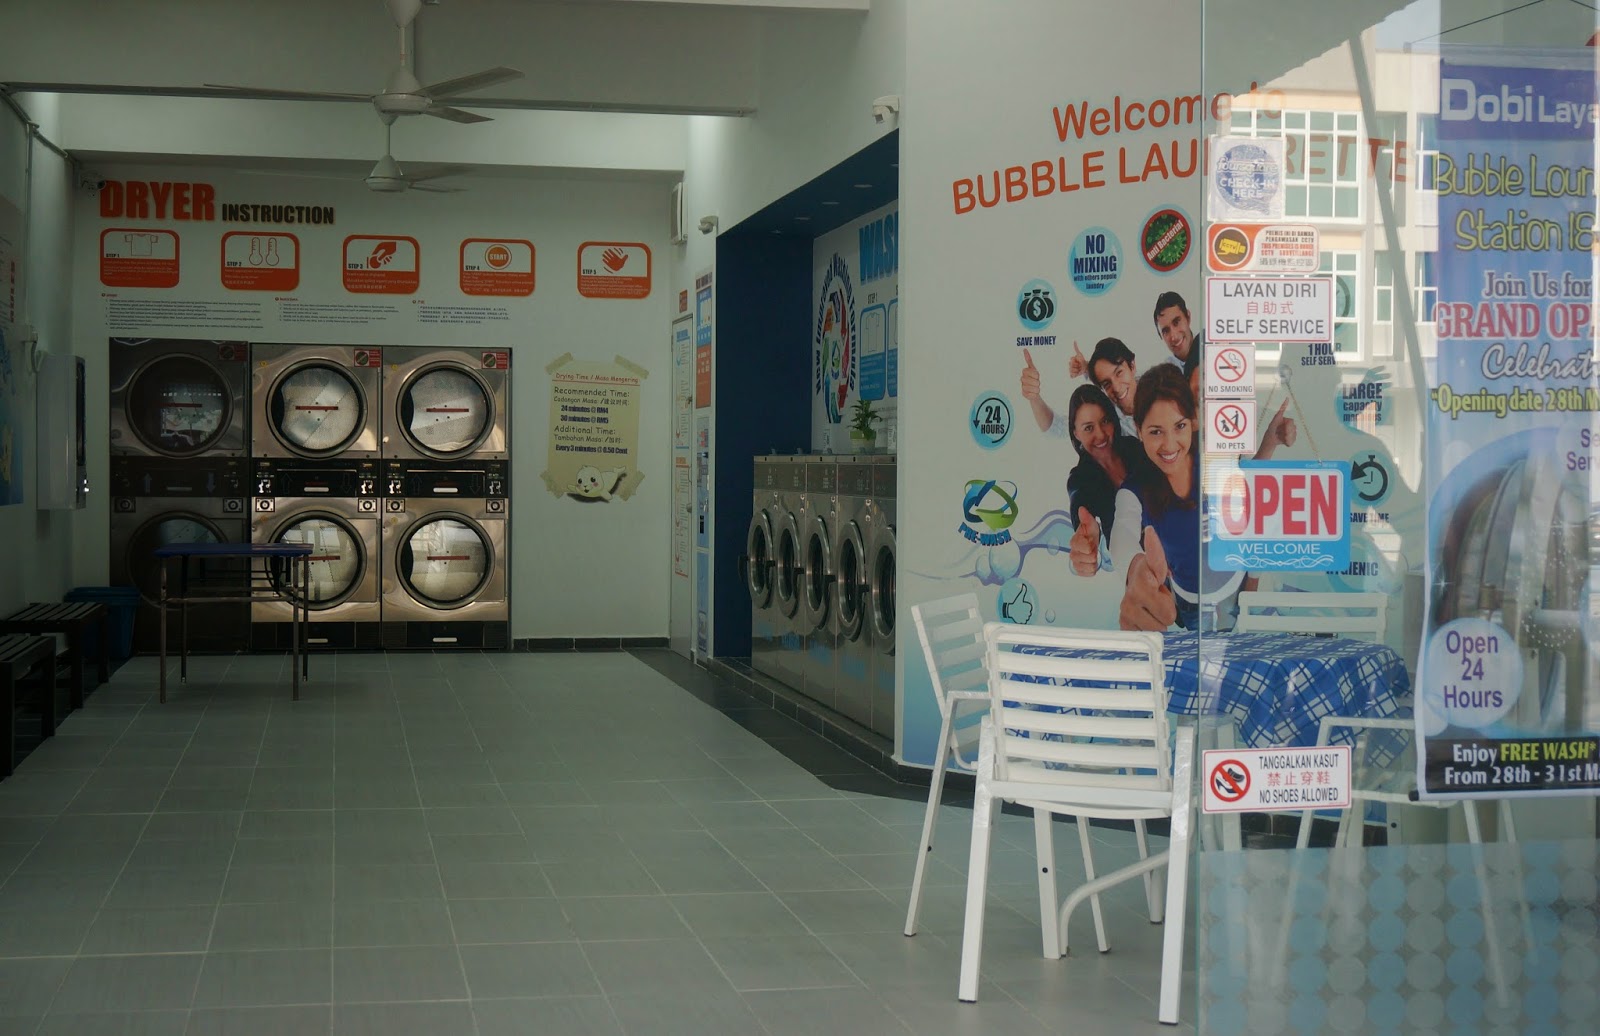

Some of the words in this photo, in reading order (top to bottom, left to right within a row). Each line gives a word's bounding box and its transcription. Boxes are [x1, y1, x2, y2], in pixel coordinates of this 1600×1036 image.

[1441, 78, 1533, 122] Dobi
[1052, 92, 1233, 142] Welcome
[952, 150, 1106, 215] BUBBLE
[1119, 134, 1411, 184] LAURETTE
[1217, 156, 1278, 175] foursquare
[1432, 152, 1525, 197] Bubble
[1220, 178, 1275, 189] CHECK-IN
[100, 180, 215, 221] DRYER
[222, 203, 334, 225] INSTRUCTION
[1232, 189, 1263, 198] HERE
[1456, 209, 1562, 251] Station
[859, 210, 898, 286] WAS
[1085, 234, 1105, 255] NO
[1147, 244, 1160, 260] Anti
[1156, 220, 1184, 252] Bacterial
[1073, 255, 1117, 274] MIXING
[1086, 282, 1104, 290] laundry
[1224, 283, 1276, 297] LAYAN
[1284, 283, 1316, 298] DIRI
[1484, 272, 1526, 297] Join
[1531, 272, 1558, 297] Us
[1564, 272, 1592, 297] for
[1247, 301, 1294, 315] 自助式
[1216, 319, 1253, 334] SELF
[1259, 319, 1324, 334] SERVICE
[1432, 302, 1540, 338] GRAND
[1016, 336, 1033, 347] SAVE
[1034, 335, 1056, 346] MONEY
[1308, 344, 1313, 356] 1
[1315, 343, 1341, 355] HOUR
[1301, 357, 1317, 366] SELF
[1319, 356, 1348, 365] SERV
[1482, 343, 1599, 380] Celebrat
[554, 386, 607, 396] Recommended
[610, 389, 630, 398] Time:
[1342, 383, 1382, 399] LARGE
[1508, 386, 1543, 412] date
[1545, 386, 1582, 412] 28th
[985, 406, 1001, 424] 24
[1343, 400, 1382, 412] capay
[1343, 412, 1382, 422] maes
[554, 425, 592, 434] Additional
[981, 424, 1005, 434] HOURS
[556, 444, 570, 452] Every
[1567, 452, 1600, 471] Ser
[1222, 474, 1337, 535] OPEN
[1350, 512, 1367, 523] SAVE
[1370, 513, 1389, 523] TME
[958, 522, 1012, 546] PRE-WASH
[1238, 543, 1321, 554] WELCOME
[1326, 562, 1378, 576] IENIC
[1446, 630, 1498, 659] Open
[1461, 658, 1484, 681] 24
[1444, 685, 1503, 709] Hours
[1259, 755, 1311, 770] TANGGALKAN
[1313, 754, 1339, 768] KASUT
[1453, 743, 1497, 767] Enjoy
[1501, 743, 1539, 762] FREE
[1267, 771, 1331, 786] 禁止穿鞋
[1445, 767, 1487, 785] From
[1492, 764, 1530, 783] 28th
[1545, 764, 1582, 782] 31st
[1585, 763, 1600, 781] M
[1260, 789, 1271, 803] NO
[1273, 788, 1299, 803] SHOES
[1302, 787, 1339, 802] ALLOWED
